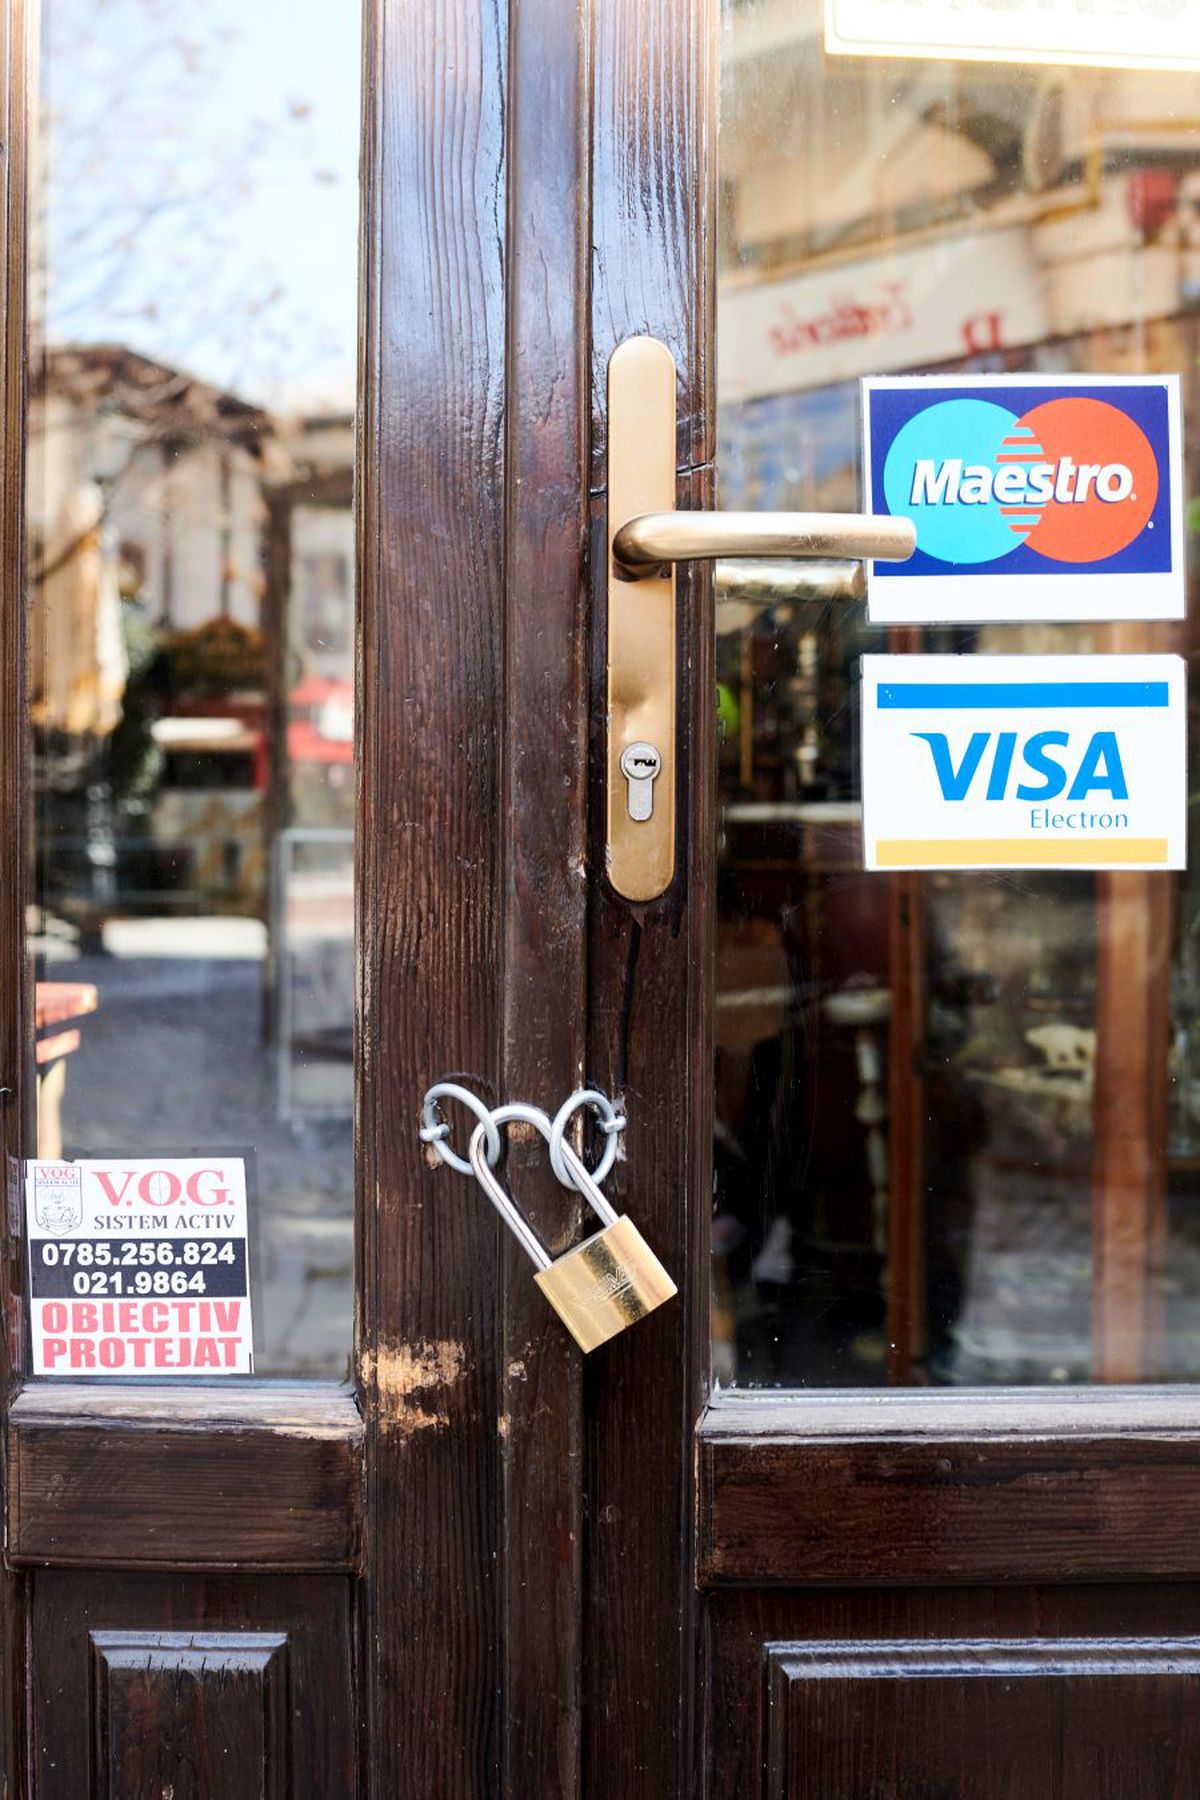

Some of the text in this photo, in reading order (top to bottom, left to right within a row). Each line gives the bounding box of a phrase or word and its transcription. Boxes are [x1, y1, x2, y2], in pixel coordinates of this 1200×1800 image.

[909, 730, 1129, 802] VISA
[1030, 809, 1128, 829] Electron
[92, 1170, 235, 1206] V.O.G.
[94, 1215, 235, 1230] SISTEM ACTIV
[41, 1242, 236, 1266] 0785.256.824
[73, 1271, 206, 1294] 021.9864
[42, 1302, 241, 1333] OBIECTIV
[43, 1338, 242, 1368] PROTEJAT
